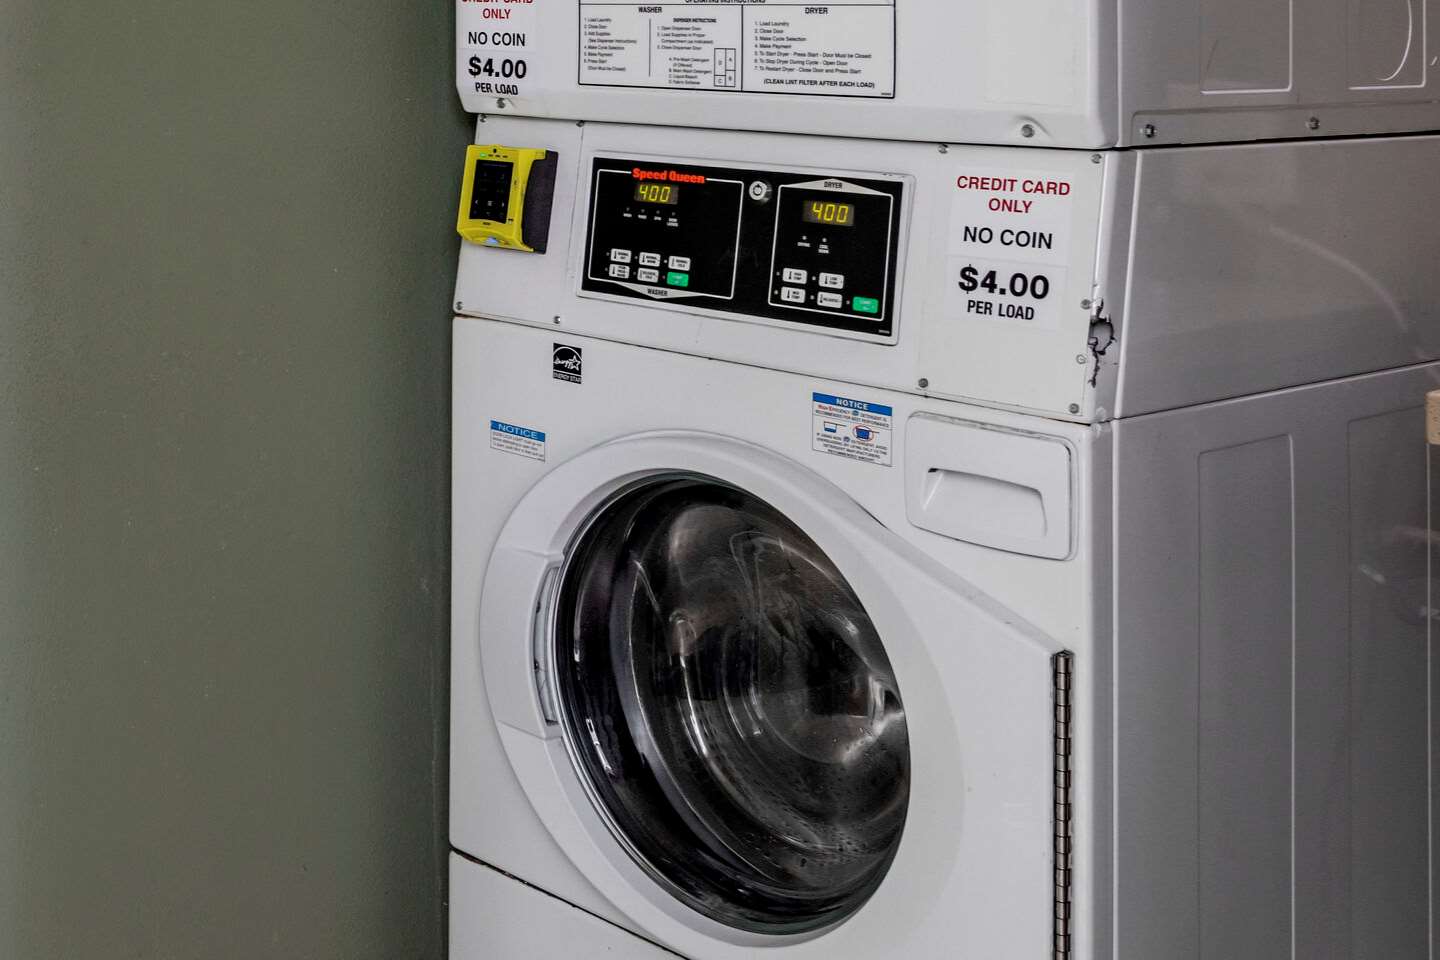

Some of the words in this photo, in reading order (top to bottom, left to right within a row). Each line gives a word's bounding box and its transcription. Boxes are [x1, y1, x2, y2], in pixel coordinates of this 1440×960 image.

[483, 8, 511, 19] ONLY
[468, 32, 487, 44] NO
[492, 32, 525, 46] COIN
[468, 54, 526, 79] $4.00
[475, 82, 492, 93] PER
[495, 84, 518, 95] LOAD
[632, 168, 667, 181] Speed
[669, 171, 705, 183] Queen
[639, 184, 671, 202] 400
[957, 176, 1017, 192] CREDIT
[1022, 180, 1070, 195] CARD
[812, 202, 849, 223] 400
[988, 198, 1032, 213] ONLY
[963, 226, 993, 244] NO
[1001, 229, 1052, 249] COIN
[958, 264, 1049, 299] $4.00
[967, 300, 992, 315] PER
[999, 304, 1034, 320] LOAD
[837, 399, 868, 410] NOTICE
[498, 424, 538, 439] NOTICE
